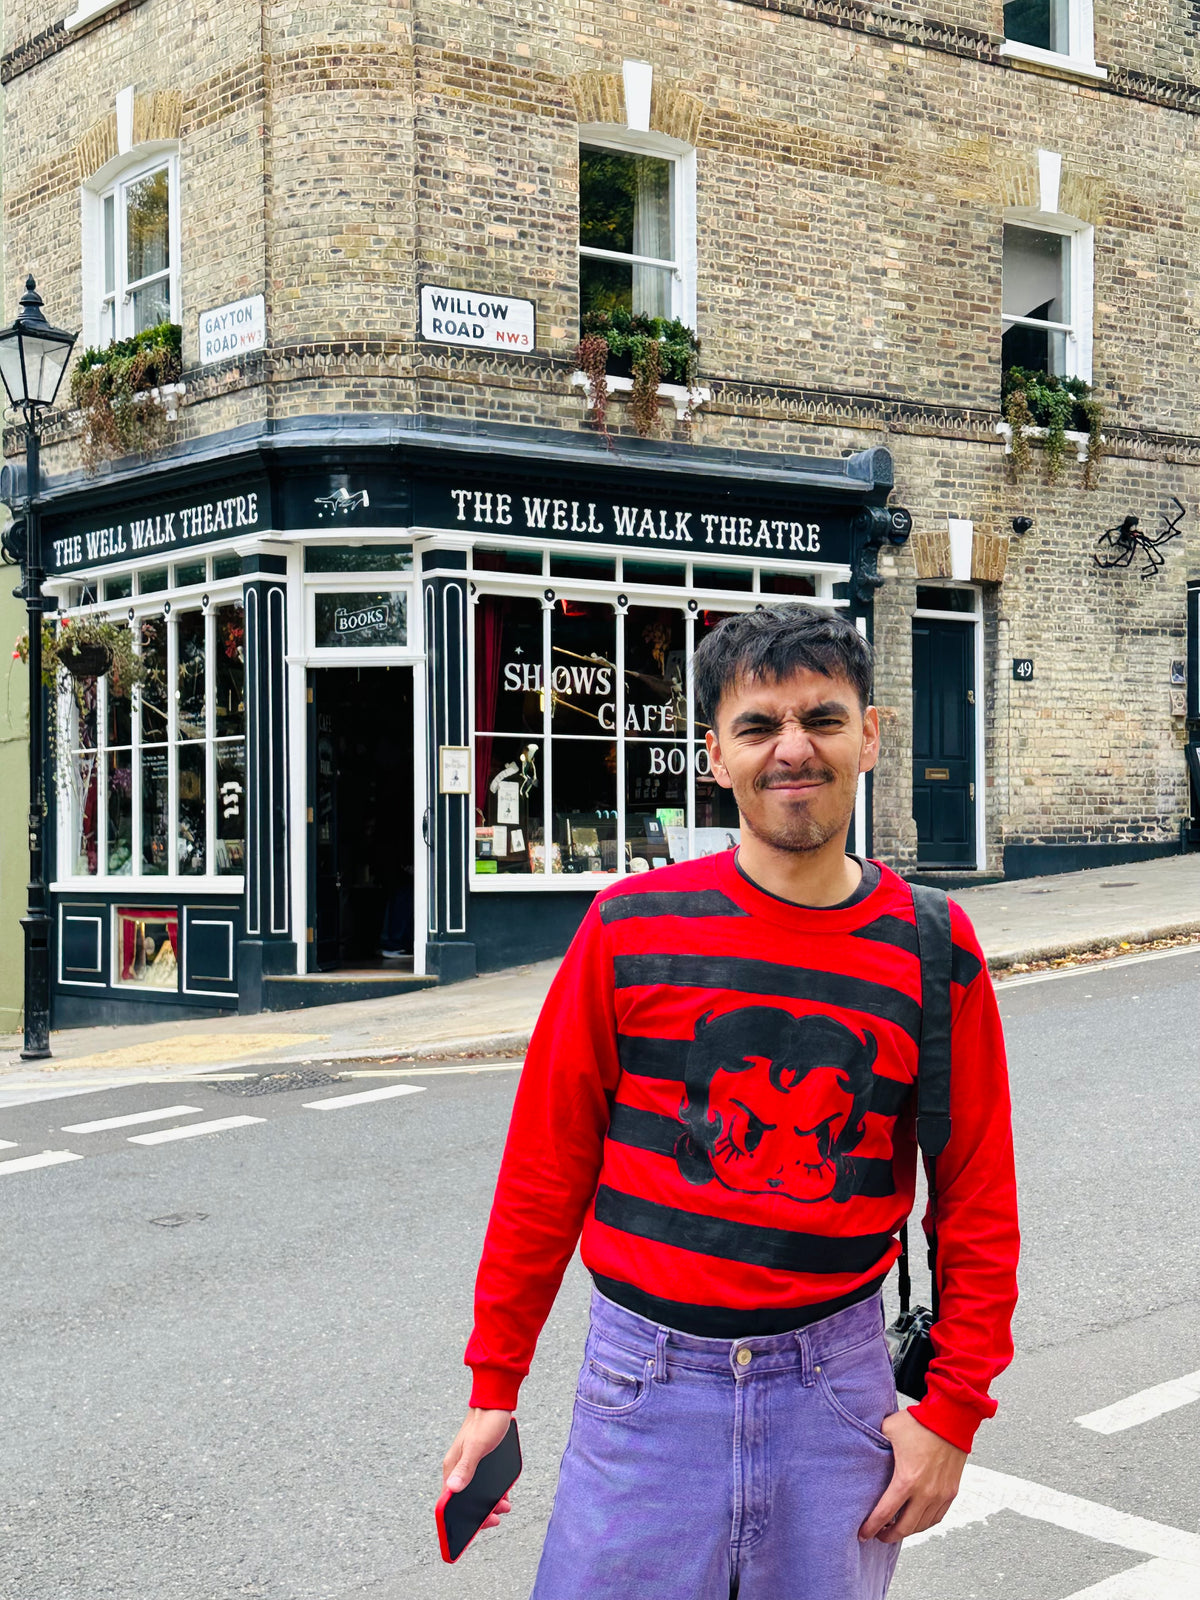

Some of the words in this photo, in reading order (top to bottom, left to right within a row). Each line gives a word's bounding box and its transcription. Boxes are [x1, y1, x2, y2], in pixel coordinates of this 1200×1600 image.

[205, 305, 253, 334] GAYTON
[431, 294, 508, 320] WILLOW
[206, 333, 238, 357] ROAD
[240, 329, 262, 346] NW3
[432, 317, 485, 339] ROAD
[496, 330, 529, 345] NW3
[53, 535, 83, 567] THE
[85, 525, 127, 561] WELL
[130, 513, 177, 551] WALK
[180, 492, 259, 540] THEATRE
[451, 489, 513, 525] THE
[522, 496, 604, 534] WELL
[612, 505, 693, 541] WALK
[700, 513, 821, 553] THEATRE
[340, 609, 383, 630] BOOKS
[504, 662, 612, 695] SHOWS
[1016, 661, 1032, 677] 49
[597, 698, 674, 732] CAFÉ
[649, 747, 711, 775] BOO
